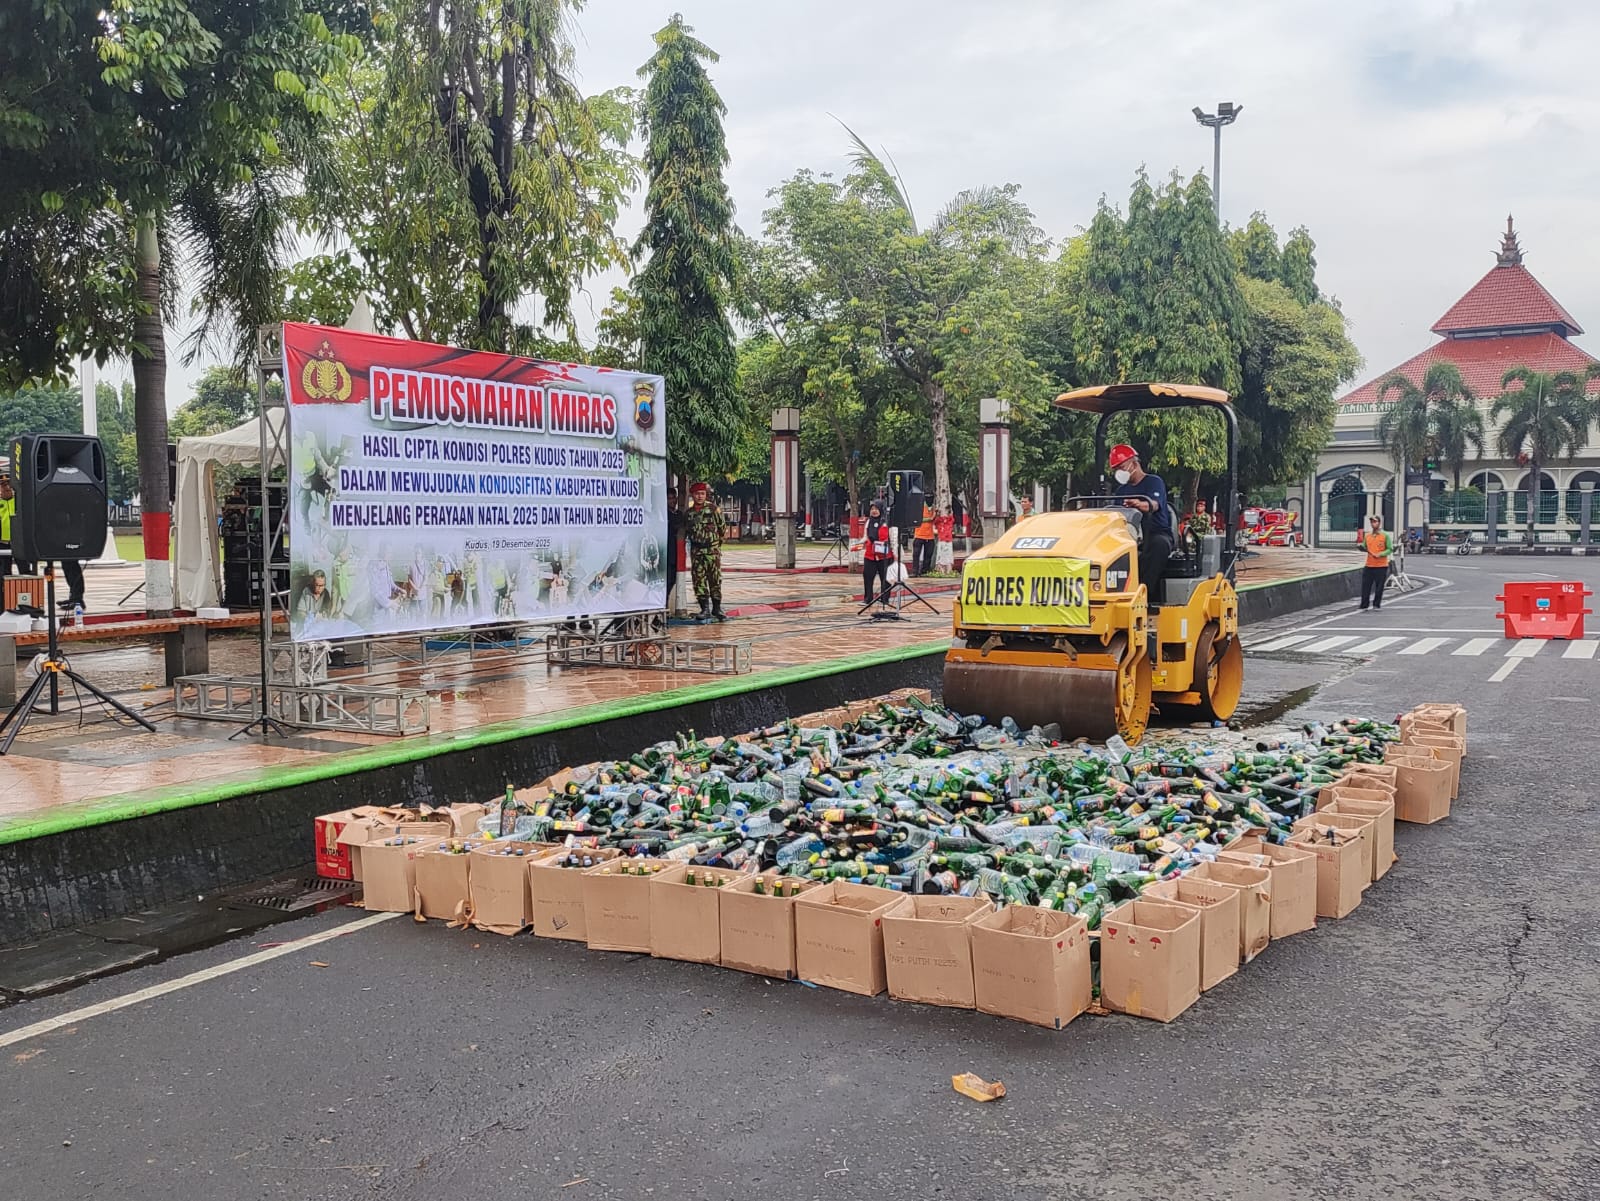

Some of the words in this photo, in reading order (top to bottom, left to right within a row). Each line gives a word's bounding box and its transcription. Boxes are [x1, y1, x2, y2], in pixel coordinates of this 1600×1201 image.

[372, 370, 543, 430] PEMUSNAHAN
[550, 391, 615, 436] MIRAS
[363, 435, 400, 458] HASIL
[404, 438, 440, 460] CIPTA
[443, 441, 488, 463] KONDISI
[492, 443, 531, 465] POLRES
[534, 447, 566, 467] KUDUS
[569, 449, 599, 468] TAHUN
[602, 451, 623, 469] 2025
[340, 469, 387, 491] DALAM
[391, 471, 475, 494] MEWUJUDKAN
[479, 474, 552, 495] KONDUSIFITAS
[555, 477, 607, 497] KABUPATEN
[610, 479, 639, 498] KUDUS
[332, 504, 411, 526] MENJELANG
[415, 505, 474, 526] PERAYAAN
[478, 506, 510, 526] NATAL
[513, 506, 538, 525] 2025
[541, 507, 561, 525] DAN
[564, 507, 594, 525] TAHUN
[596, 507, 620, 525] BARU
[622, 507, 643, 525] 2026
[465, 540, 490, 550] Kudus,
[492, 540, 500, 549] 19
[501, 539, 534, 549] Desember
[535, 538, 551, 548] 2025
[1015, 538, 1056, 549] CAT
[965, 576, 1025, 607] POLRES
[1029, 576, 1085, 608] KUDUS
